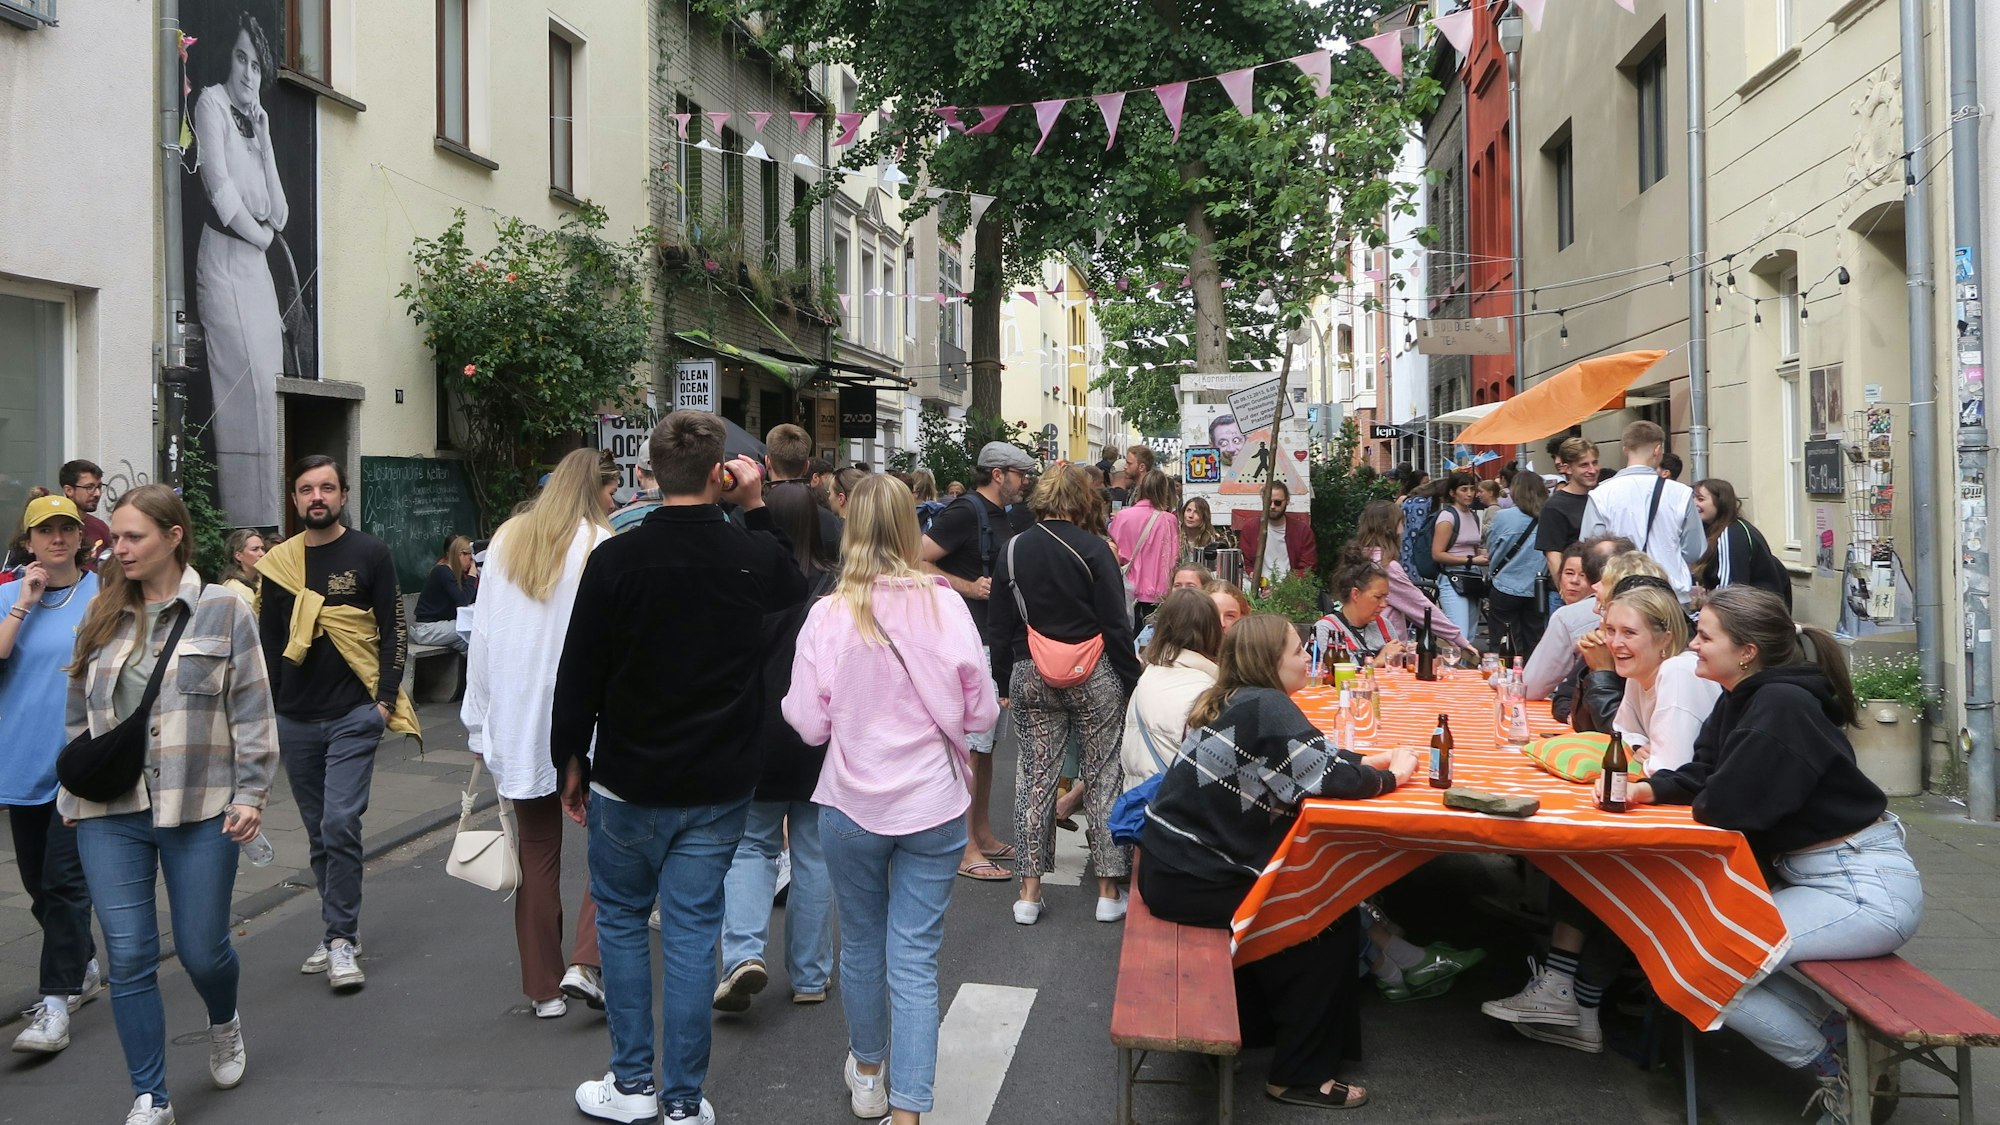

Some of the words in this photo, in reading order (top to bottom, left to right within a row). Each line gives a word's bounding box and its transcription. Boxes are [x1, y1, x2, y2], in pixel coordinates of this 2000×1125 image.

[680, 370, 708, 380] CLEAN
[680, 382, 708, 393] OCEAN
[680, 395, 708, 405] STORE
[1251, 392, 1278, 405] Grundstück
[599, 1083, 612, 1104] N
